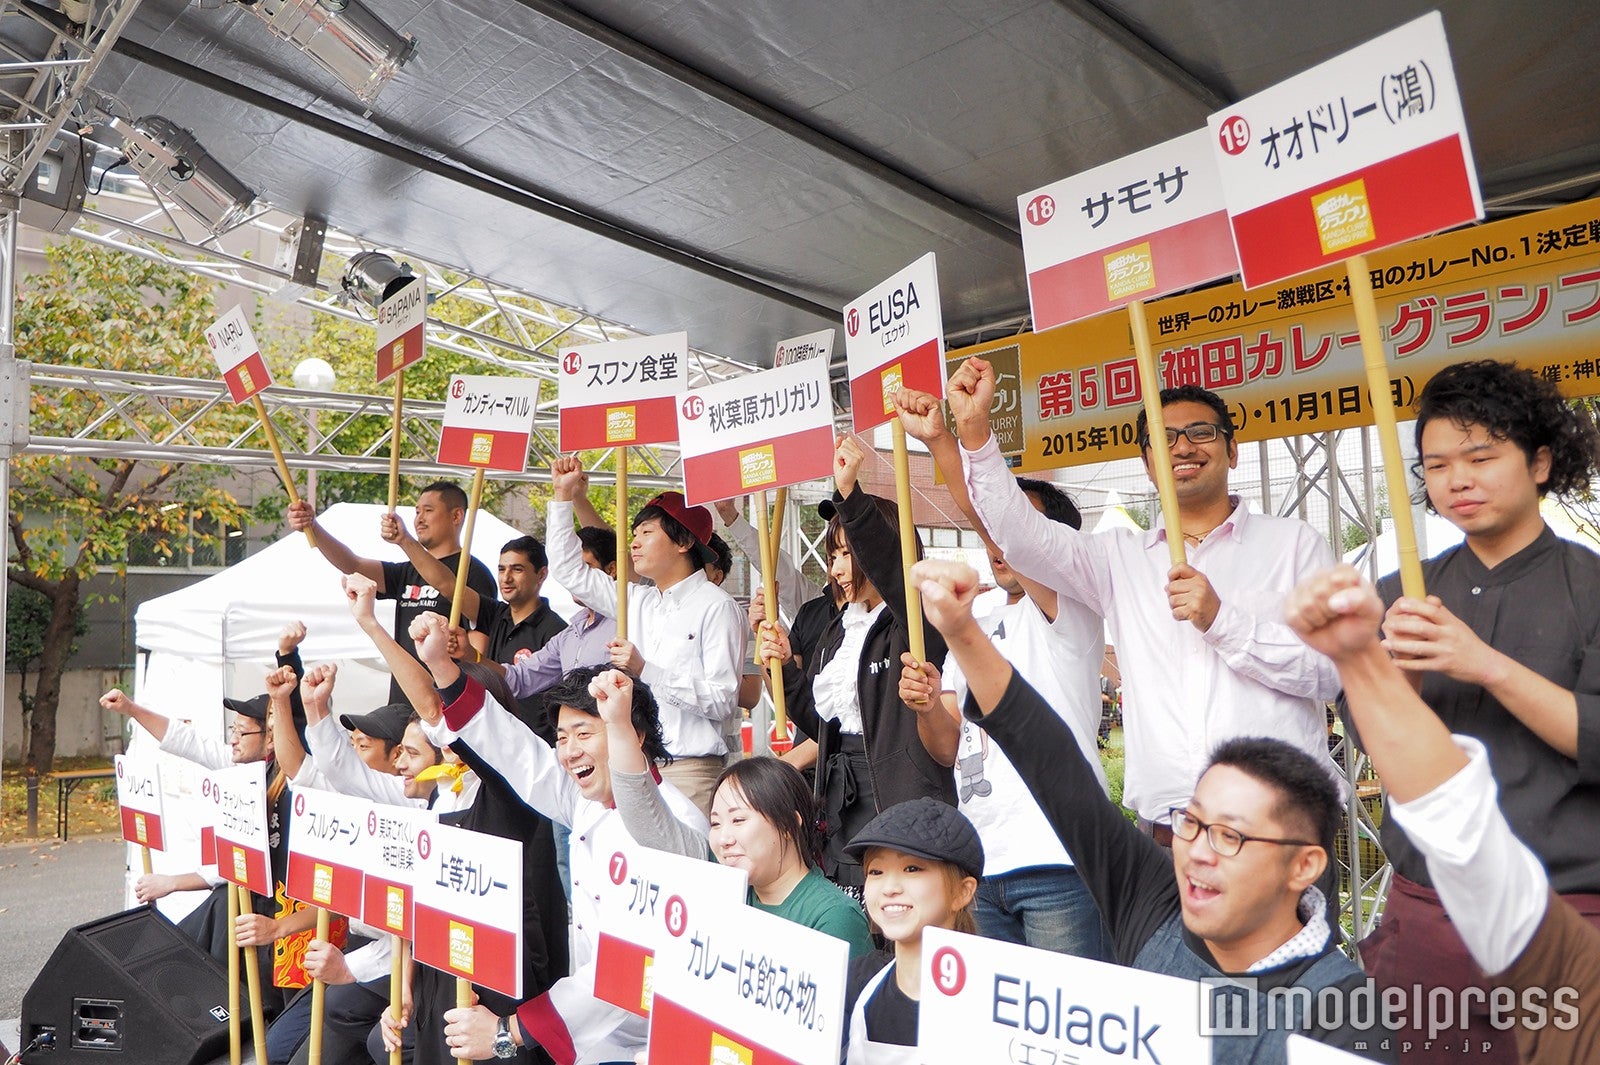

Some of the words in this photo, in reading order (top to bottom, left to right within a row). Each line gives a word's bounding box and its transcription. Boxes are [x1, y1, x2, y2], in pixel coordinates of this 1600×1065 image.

[1220, 117, 1249, 153] 19
[1027, 196, 1054, 224] 18
[1081, 166, 1189, 229] サモサ
[387, 287, 421, 324] SAPANA
[847, 309, 859, 336] 17
[869, 281, 920, 335] EUSA
[217, 318, 244, 349] NARU
[881, 320, 910, 348] (エウサ)
[564, 354, 581, 373] 14
[587, 353, 678, 387] スワン食堂
[452, 381, 465, 398] 13
[463, 392, 530, 417] ガンディーマハル
[1039, 357, 1143, 419] 第5回
[683, 397, 704, 419] 16
[709, 380, 820, 433] 秋葉原カリガリ
[990, 415, 1018, 431] URRY
[1042, 421, 1140, 457] 2015年10
[307, 812, 360, 846] スルターン
[419, 832, 430, 857] 6
[436, 852, 508, 896] 上等カレー
[612, 854, 626, 882] 7
[629, 875, 660, 917] プリマ
[667, 898, 684, 934] 8
[687, 930, 825, 1032] カレーは飲み物。
[935, 949, 962, 993] 9
[993, 973, 1161, 1065] Eblack
